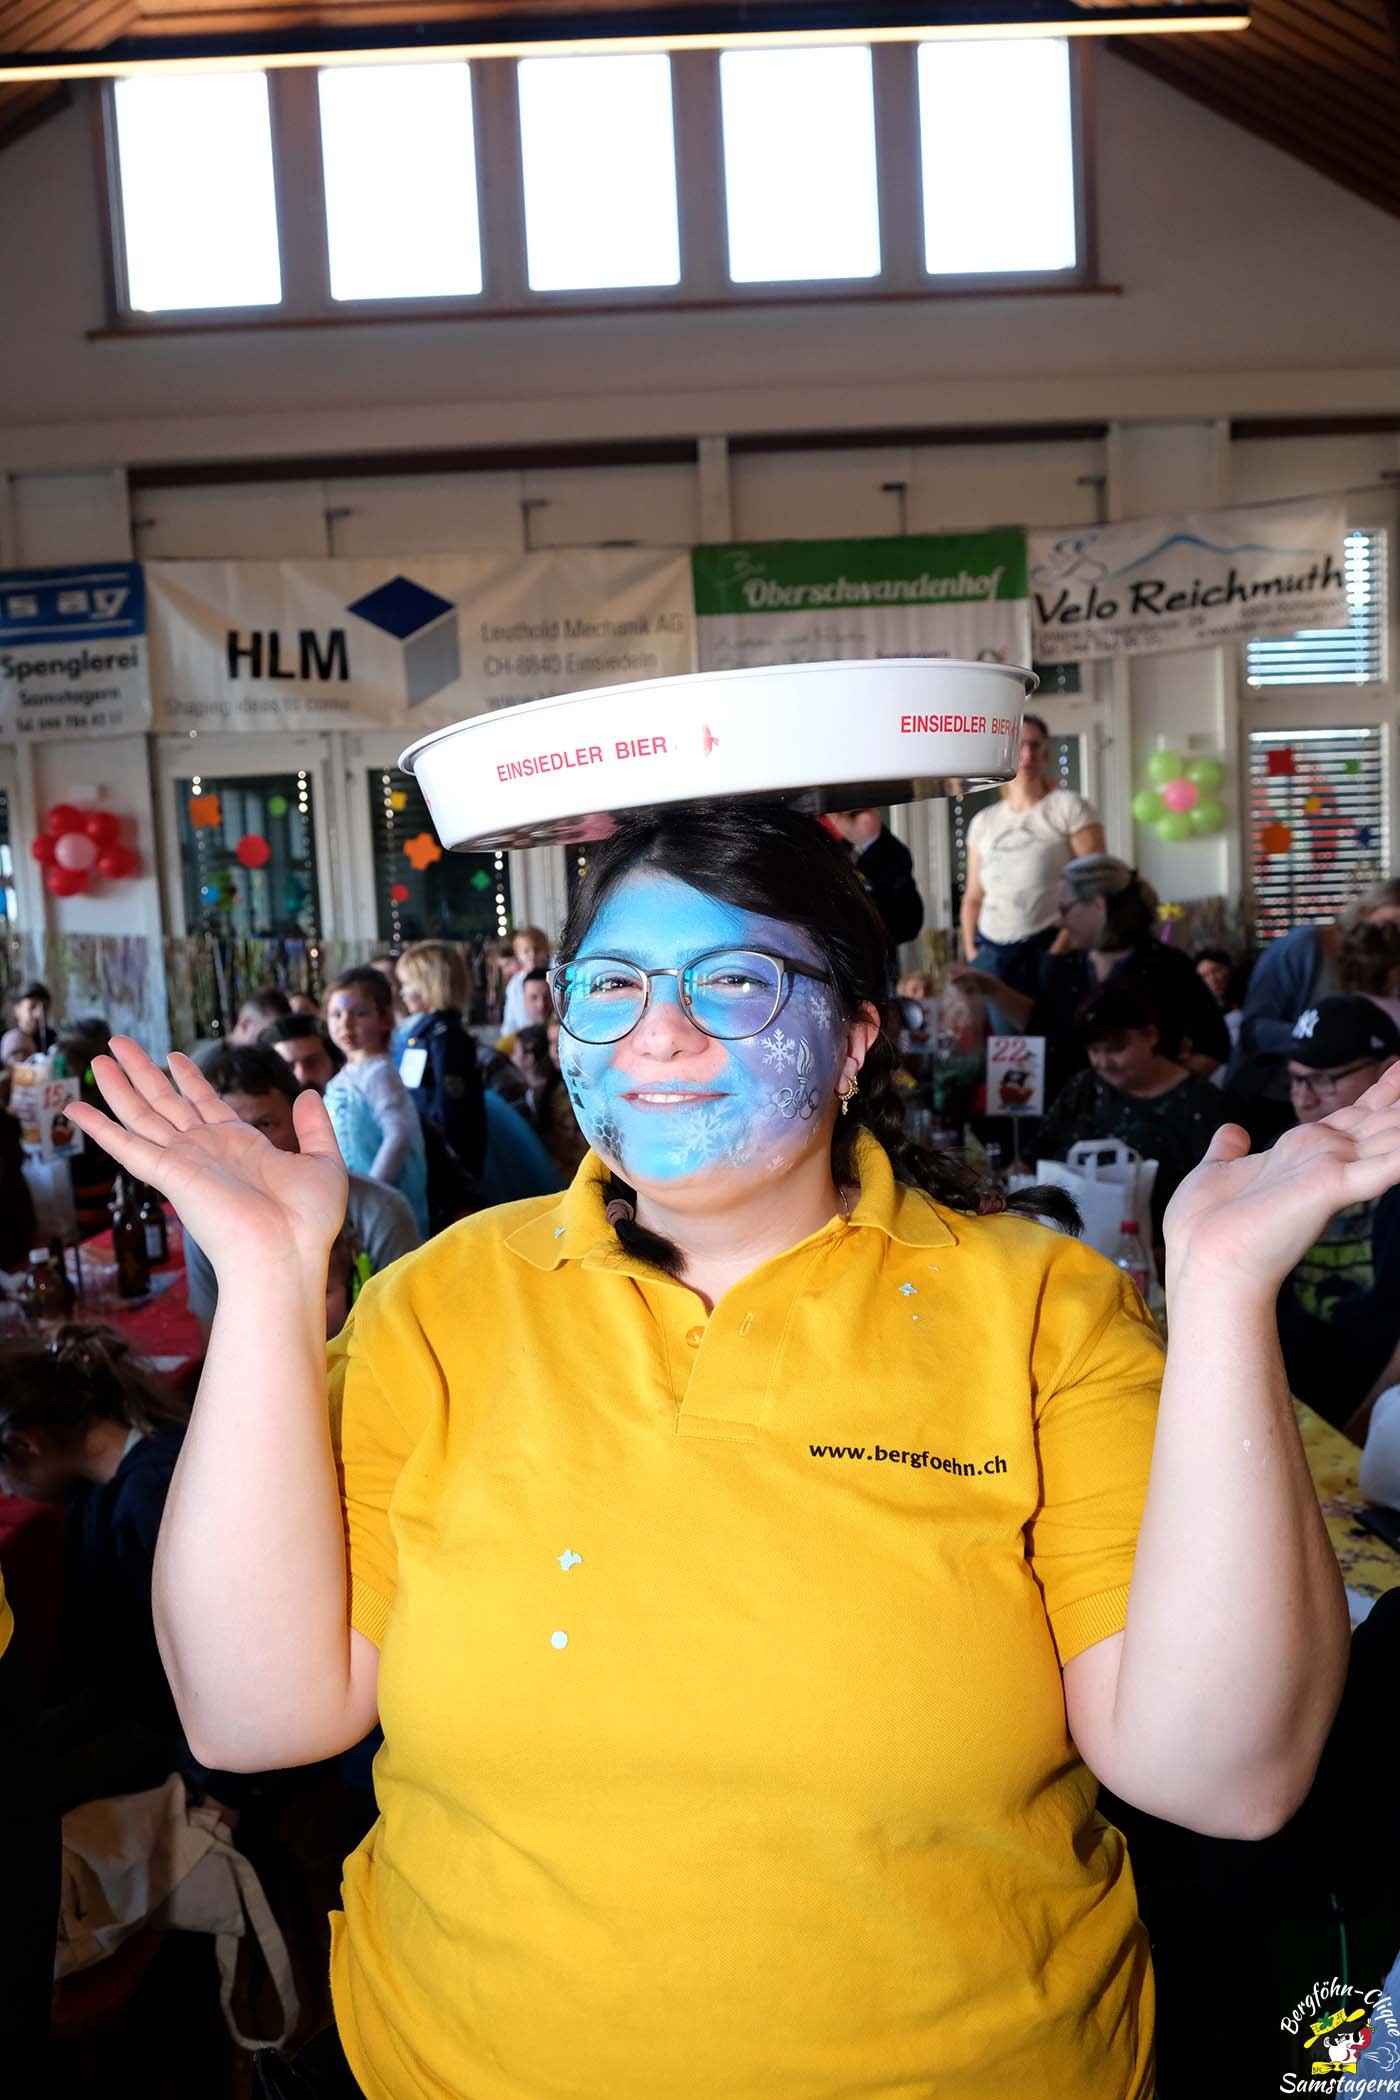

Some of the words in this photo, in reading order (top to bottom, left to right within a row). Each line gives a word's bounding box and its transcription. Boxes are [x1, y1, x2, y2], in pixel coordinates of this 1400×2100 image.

[742, 566, 1006, 608] Oberschwandenhof
[1034, 588, 1118, 624] Velo
[1129, 554, 1345, 614] Reichmuth
[480, 619, 560, 643] Leuthold
[562, 615, 649, 640] Mechanik
[655, 612, 684, 634] AG
[0, 644, 139, 683] Spenglerei
[226, 628, 349, 681] HLM
[566, 651, 659, 674] Einsiedeln
[901, 715, 986, 734] EINSIEDLER
[991, 717, 1011, 735] BIER
[496, 745, 604, 783] EINSIEDLER
[615, 736, 668, 760] BIER
[991, 1037, 1028, 1064] 22
[809, 1444, 1008, 1477] www.bergfoehn.ch
